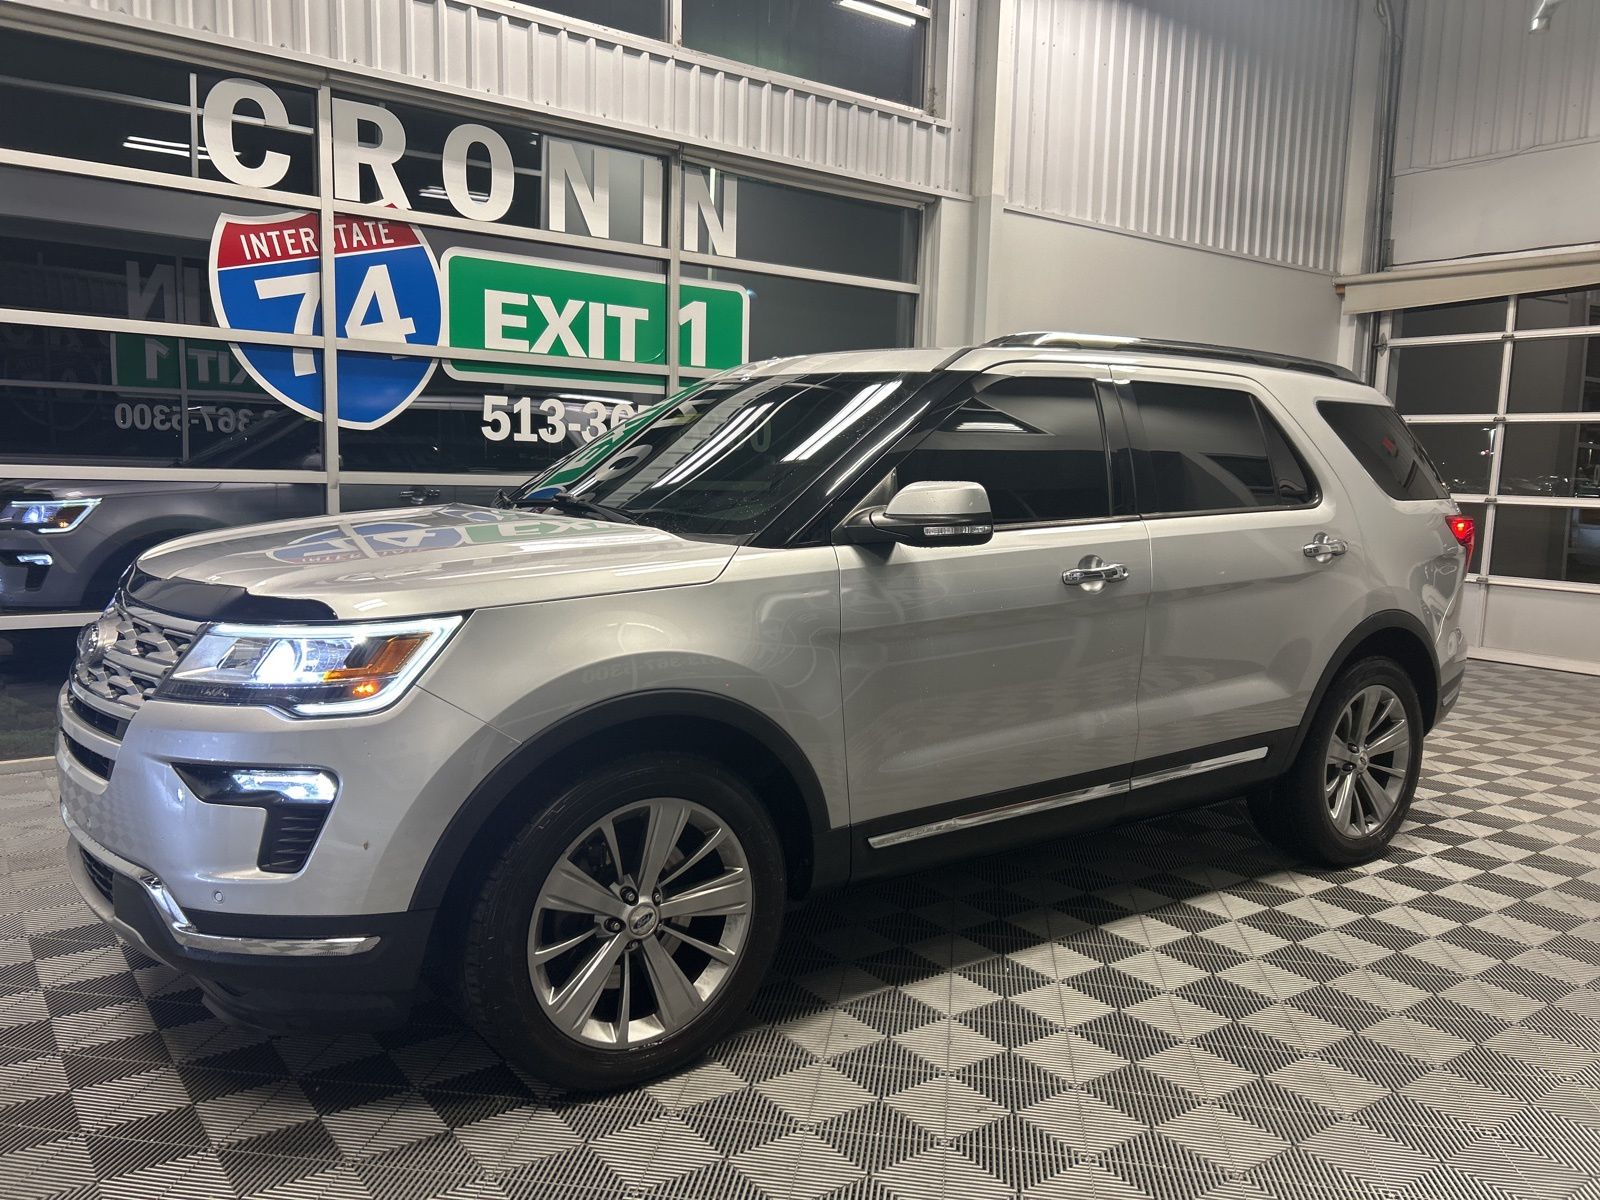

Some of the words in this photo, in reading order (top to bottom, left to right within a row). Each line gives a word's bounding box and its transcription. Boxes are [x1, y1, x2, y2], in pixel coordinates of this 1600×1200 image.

[202, 77, 738, 258] CRONIN
[239, 220, 395, 261] INTERTATE
[254, 263, 417, 377] 74
[484, 288, 650, 362] EXIT
[678, 300, 707, 367] 1
